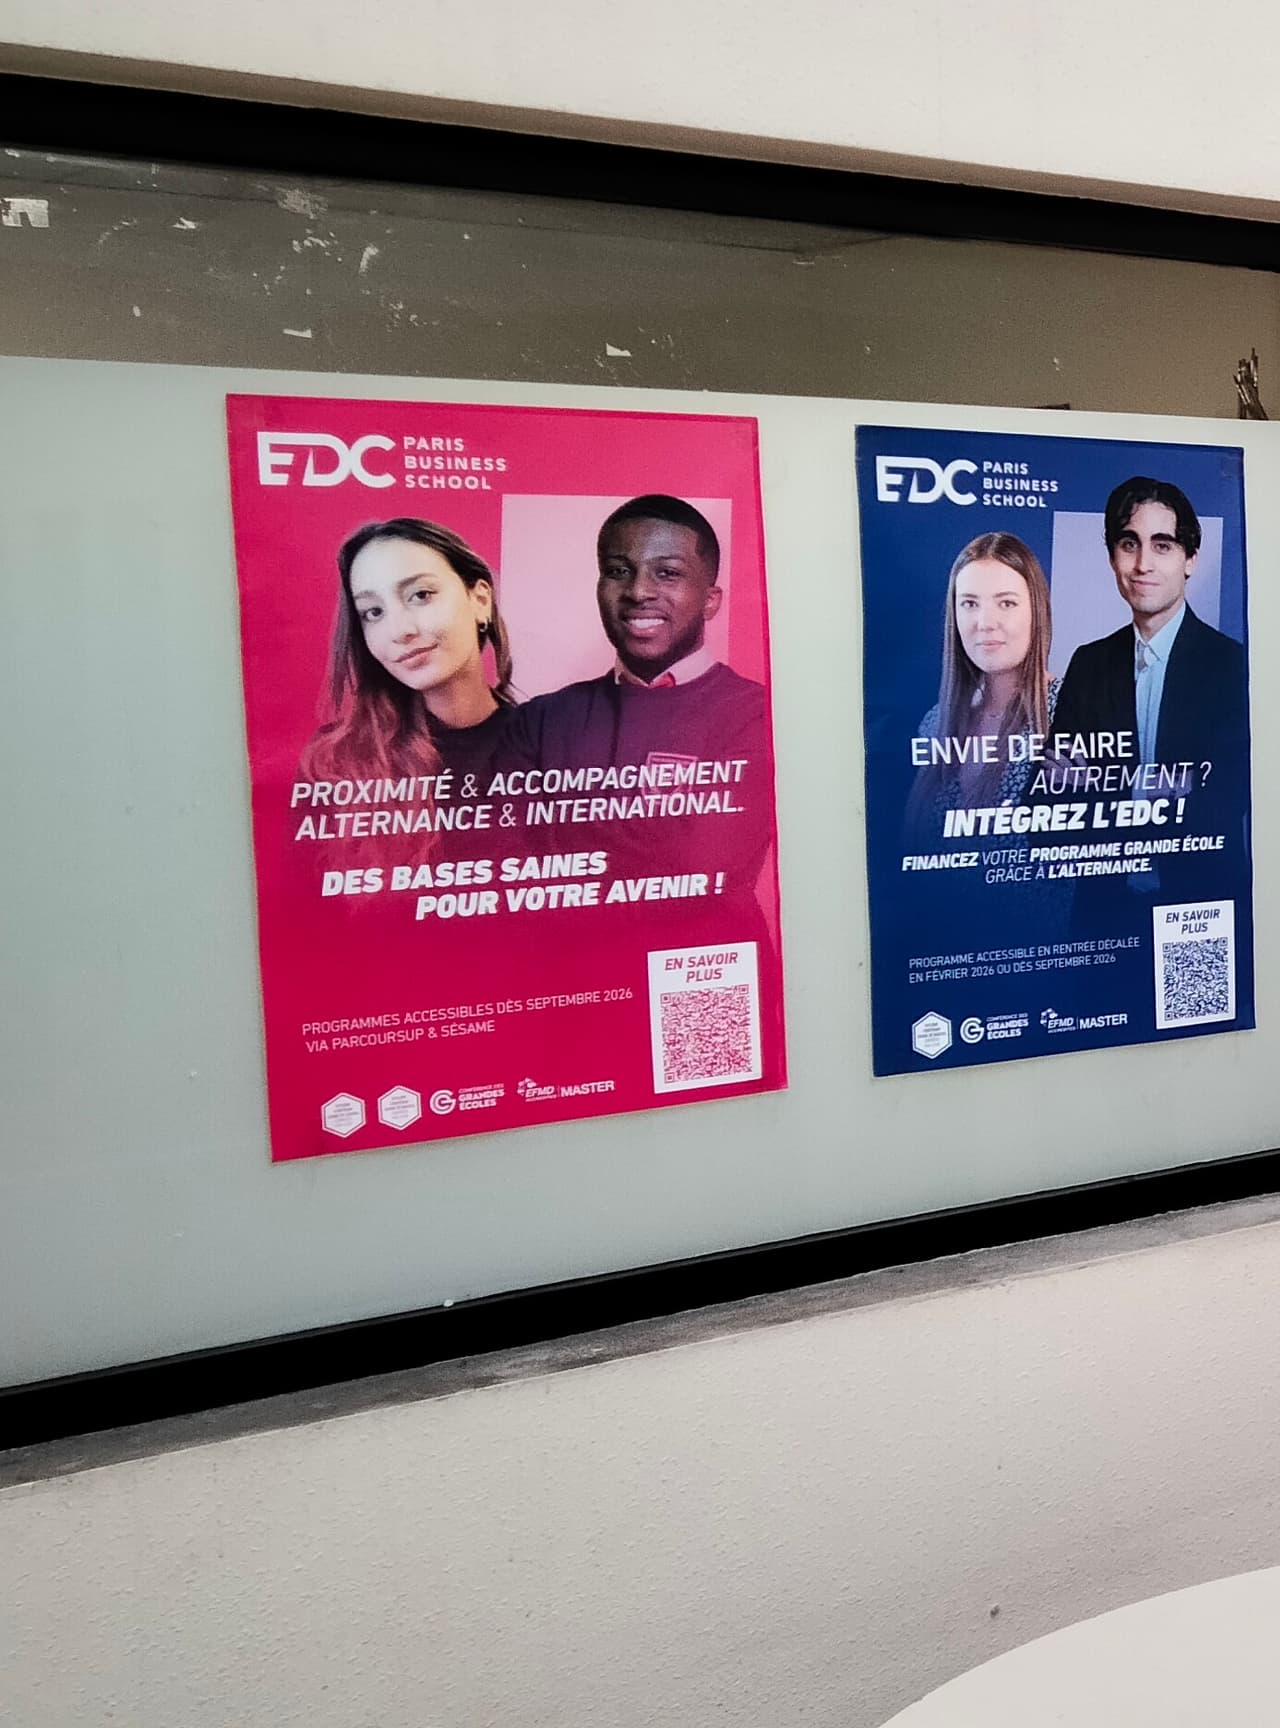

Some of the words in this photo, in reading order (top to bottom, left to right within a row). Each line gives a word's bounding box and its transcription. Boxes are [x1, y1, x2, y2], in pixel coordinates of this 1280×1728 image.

[403, 436, 465, 452] PARIS
[256, 431, 396, 489] EDC
[404, 455, 507, 472] BUSINESS
[983, 461, 1029, 475] PARIS
[405, 473, 492, 490] SCHOOL
[875, 455, 978, 506] EDC
[983, 477, 1059, 492] BUSINESS
[983, 493, 1047, 508] SCHOOL
[911, 735, 999, 766] ENVIE
[1008, 734, 1045, 761] DE
[1054, 731, 1134, 760] FAIRE
[290, 769, 453, 808] PROXIMITÉ
[460, 774, 479, 798] &
[487, 760, 748, 797] ACCOMPAGNEMENT
[1029, 762, 1194, 795] AUTREMENT
[1201, 761, 1212, 788] ?
[295, 804, 493, 841] ALTERNANCE
[499, 803, 517, 827] &
[526, 790, 745, 826] INTERNATIONAL.
[943, 798, 1088, 838] INTÉGREZ
[1176, 798, 1187, 824] !
[902, 851, 979, 871] FINANCEZ
[982, 849, 1028, 866] VOTRE
[1030, 842, 1121, 862] PROGRAMME
[1124, 838, 1181, 856] GRANDE
[1182, 834, 1225, 851] ÉCOLE
[321, 868, 383, 896] DES
[391, 860, 493, 892] BASES
[500, 851, 607, 882] SAINES
[985, 866, 1033, 884] GRÂCE
[1035, 865, 1045, 880] À
[415, 890, 498, 920] POUR
[506, 882, 601, 912] VOTRE
[605, 874, 709, 904] AVENIR
[713, 872, 725, 895] !
[1165, 912, 1180, 923] EN
[1182, 909, 1220, 921] SAVOIR
[1181, 922, 1208, 934] PLUS
[664, 958, 684, 971] EN
[686, 952, 739, 968] SAVOIR
[909, 952, 975, 969] PROGRAMME
[976, 946, 1036, 962] ACCESSIBLE
[1038, 945, 1051, 957] EN
[1053, 940, 1096, 954] RENTRÉE
[686, 969, 723, 983] PLUS
[909, 972, 923, 984] EN
[925, 968, 968, 982] FÉVRIER
[970, 965, 995, 977] 2026
[996, 963, 1011, 975] OU
[1035, 954, 1091, 971] SEPTEMBRE
[1093, 953, 1116, 965] 2026
[302, 1013, 401, 1036] PROGRAMMES
[403, 1003, 494, 1025] ACCESSIBLES
[497, 998, 523, 1015] DÈS
[526, 991, 601, 1011] SEPTEMBRE
[603, 987, 633, 1002] 2026
[986, 1018, 1029, 1031] GRANDES
[1048, 1017, 1074, 1029] EFMD
[1079, 1013, 1128, 1030] MASTER
[305, 1040, 328, 1053] VIA
[332, 1028, 424, 1051] PARCOURSUP
[428, 1028, 438, 1039] &
[441, 1018, 495, 1037] SÉSAME
[459, 1089, 505, 1102] GRANDES
[525, 1086, 555, 1098] EFMD
[561, 1080, 615, 1097] MASTER
